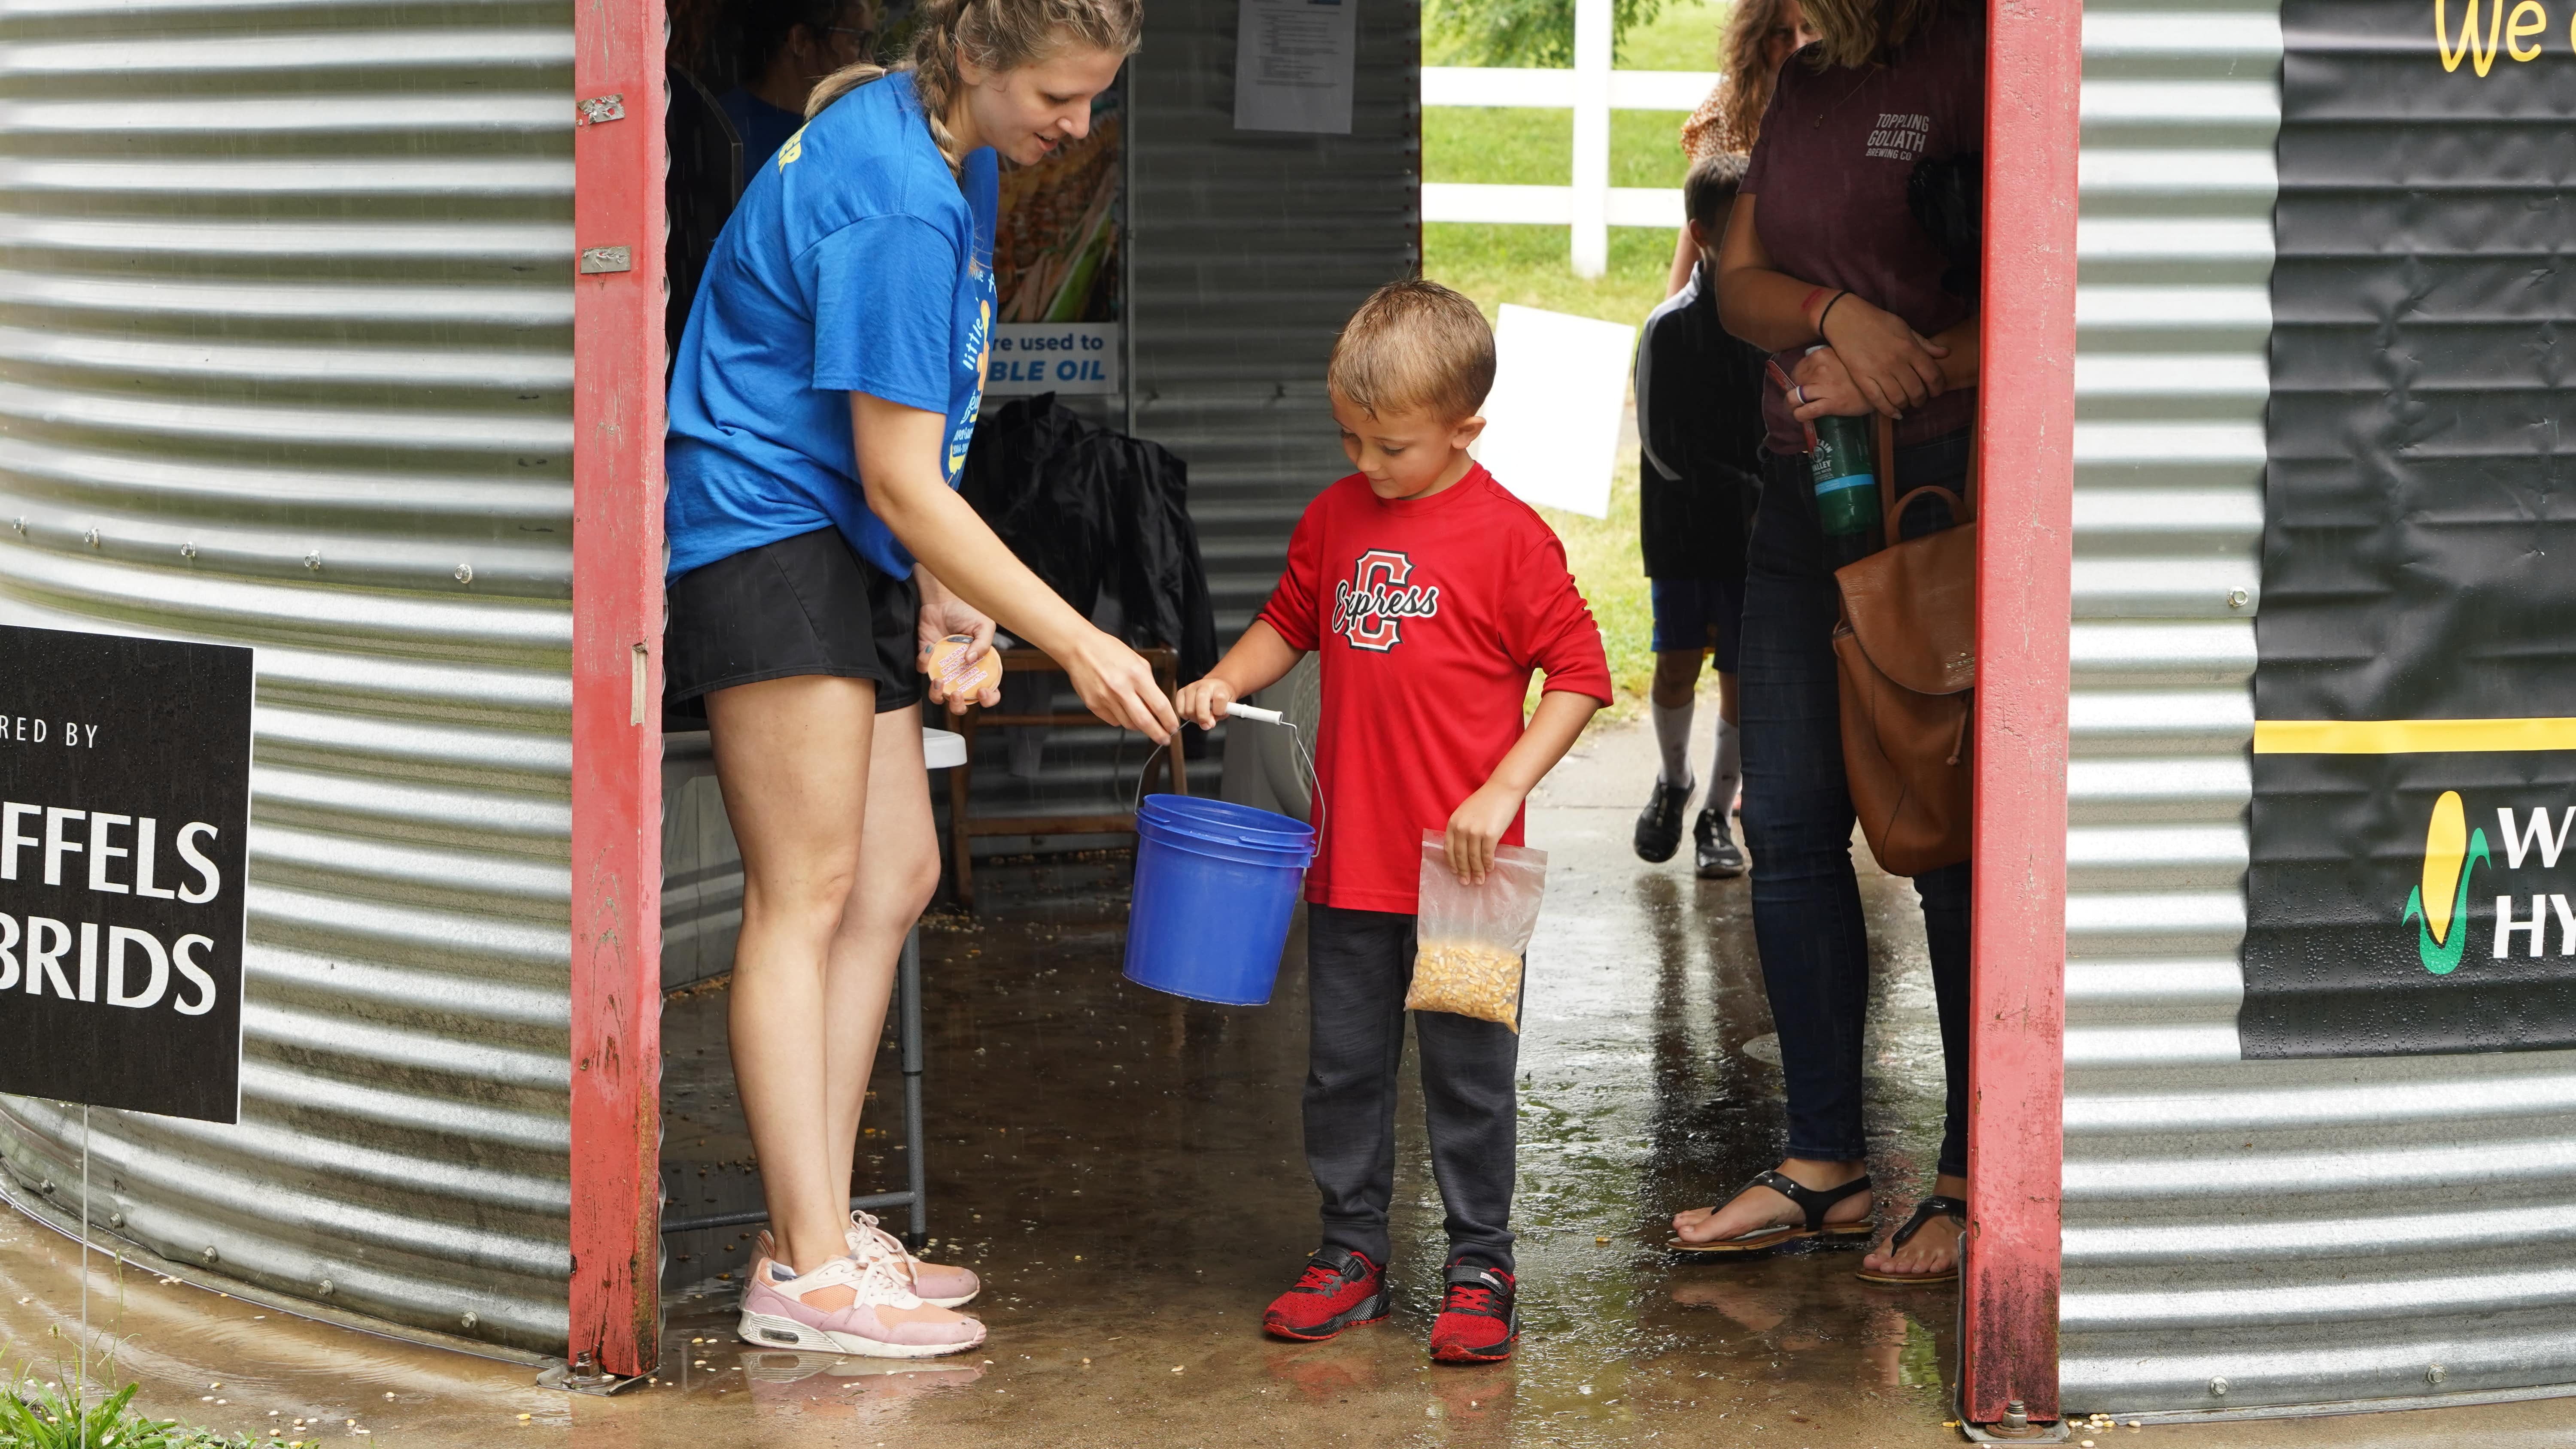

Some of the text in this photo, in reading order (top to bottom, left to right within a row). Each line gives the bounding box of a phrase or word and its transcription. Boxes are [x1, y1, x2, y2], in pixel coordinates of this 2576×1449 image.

[2435, 0, 2547, 78] We
[1876, 113, 1929, 132] TOPPLING
[1865, 149, 1899, 159] BREWING
[1867, 130, 1926, 152] GOLIATH
[963, 318, 983, 370] little
[1021, 333, 1073, 350] used
[1081, 335, 1103, 350] to
[989, 360, 1105, 381] BLE OIL
[1332, 579, 1439, 633] Express
[0, 715, 97, 748] RED BY
[0, 801, 220, 903] FFELS
